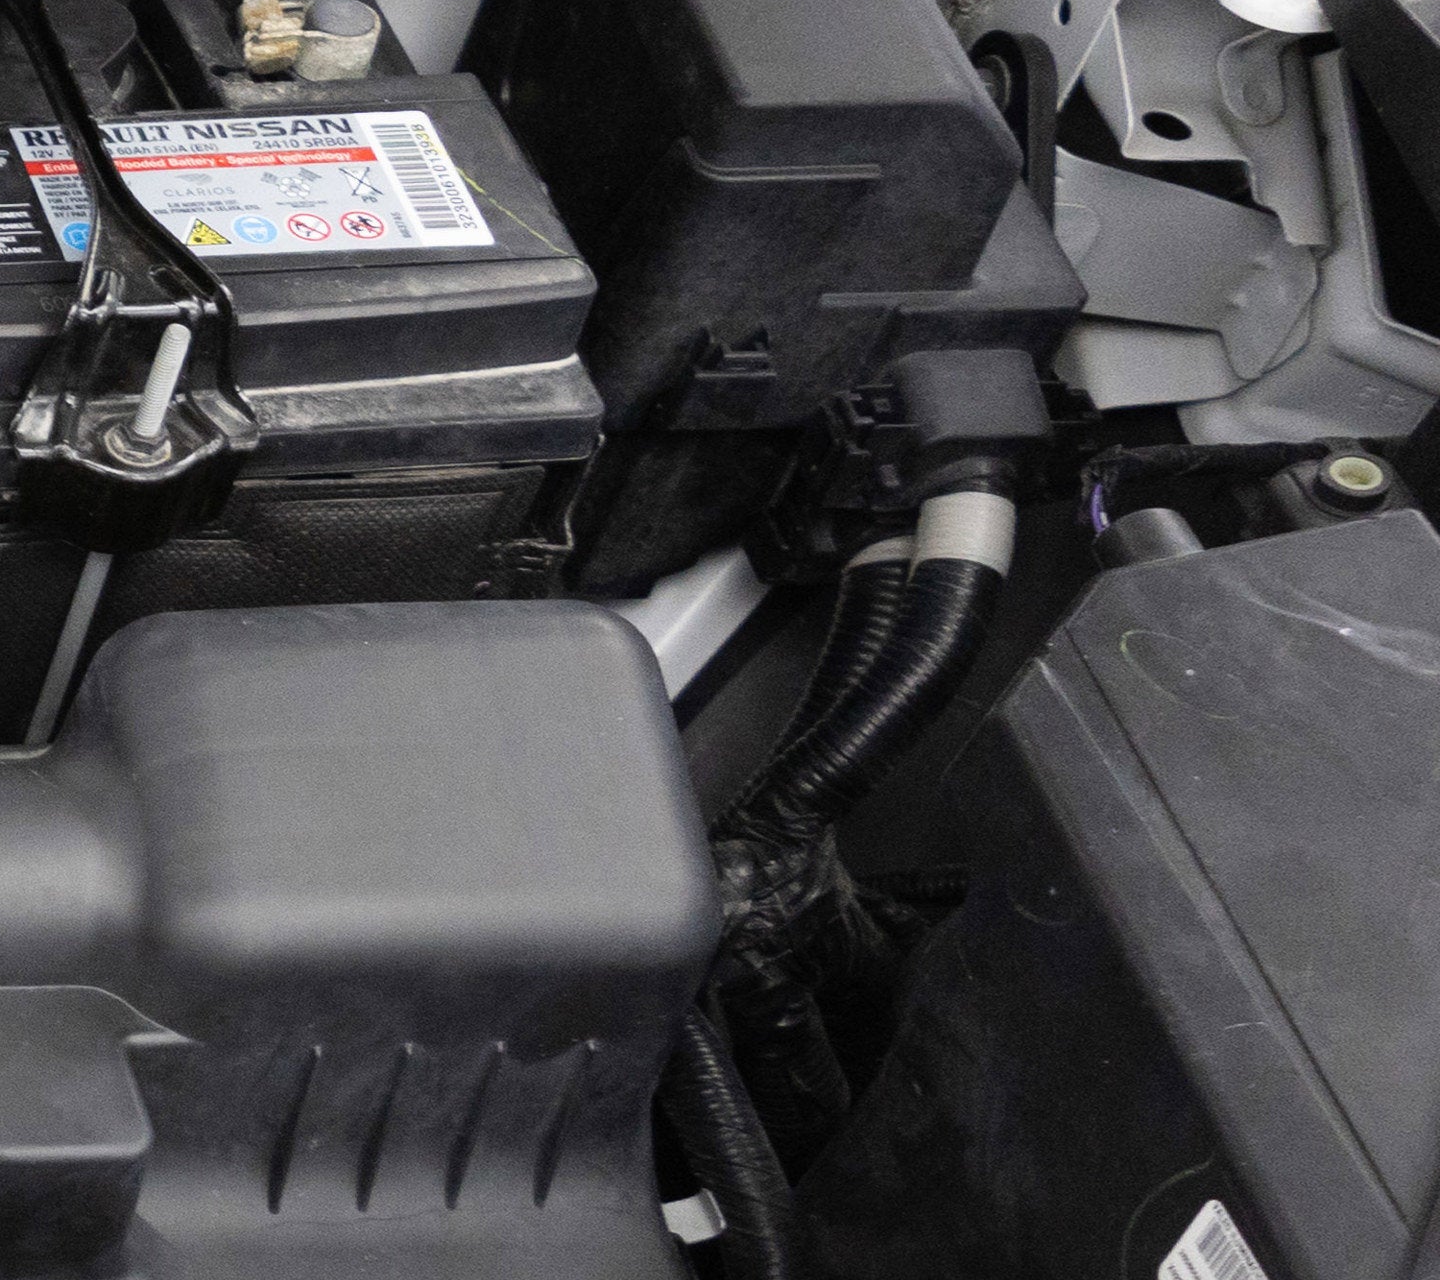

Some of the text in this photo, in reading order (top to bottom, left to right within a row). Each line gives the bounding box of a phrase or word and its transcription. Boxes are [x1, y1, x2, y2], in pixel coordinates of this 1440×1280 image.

[22, 118, 352, 147] REAULT NISSAN
[252, 139, 300, 150] 24410
[167, 156, 215, 167] Battery
[225, 154, 275, 166] Special
[278, 152, 351, 165] technology
[162, 186, 236, 198] CLARIOS
